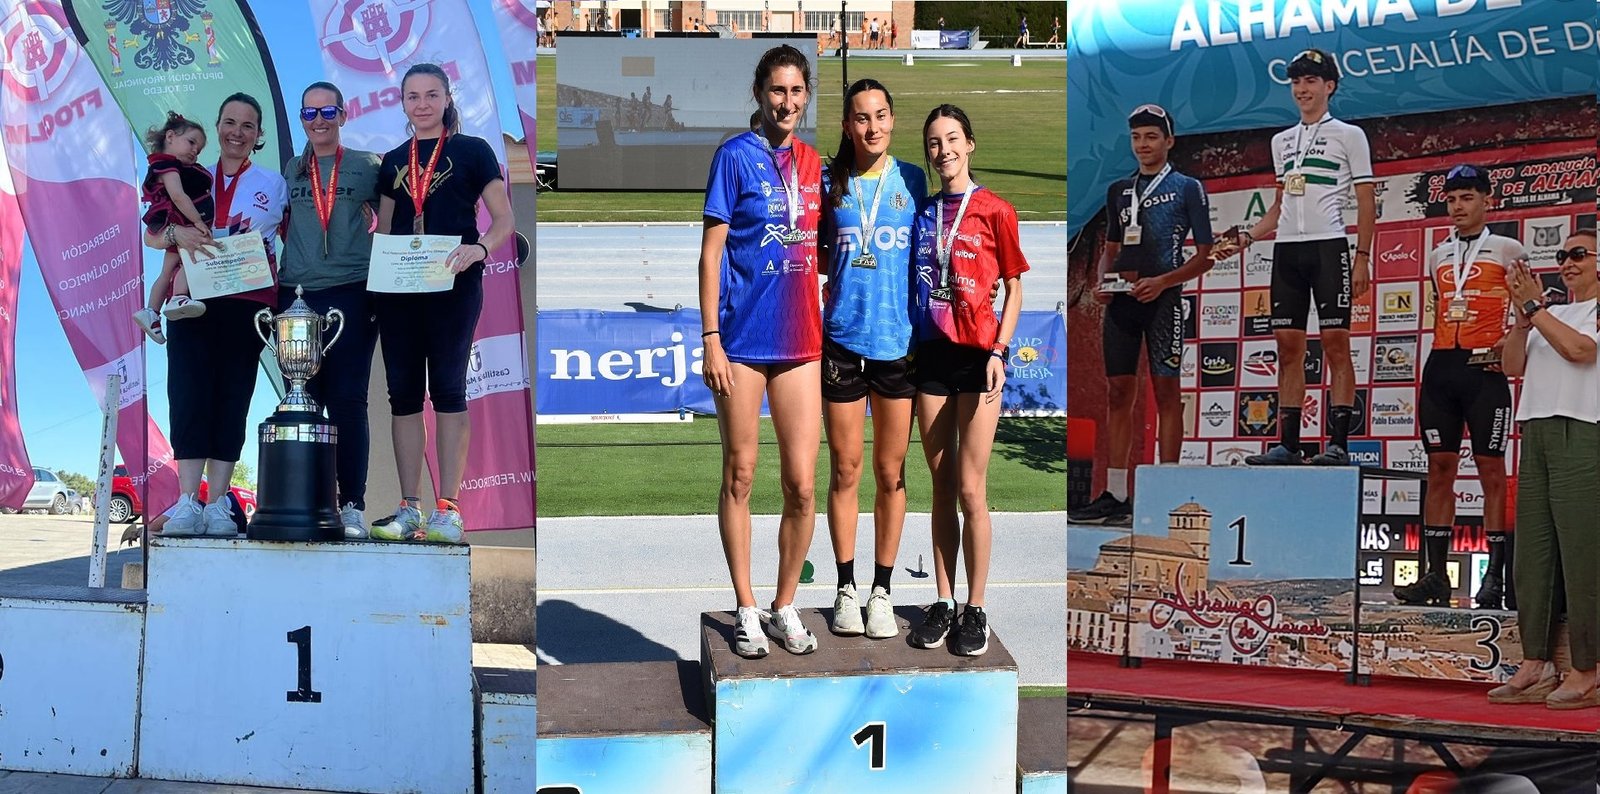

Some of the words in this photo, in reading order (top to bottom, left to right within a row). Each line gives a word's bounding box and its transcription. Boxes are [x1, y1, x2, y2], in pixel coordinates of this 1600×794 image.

[1268, 30, 1492, 85] CCEJALÍA
[1498, 26, 1556, 59] DE
[1521, 157, 1596, 177] ANDALUCÍA
[290, 187, 355, 199] Cleer
[1502, 181, 1527, 196] DE
[1120, 192, 1177, 223] gaosur
[1372, 403, 1400, 411] Pinturas
[1372, 416, 1387, 425] Pablo
[1388, 416, 1414, 425] Escobedo
[1348, 452, 1379, 462] THLON
[1228, 515, 1252, 567] 1
[1469, 615, 1501, 672] 3
[286, 625, 322, 703] 1
[850, 722, 887, 771] 1
